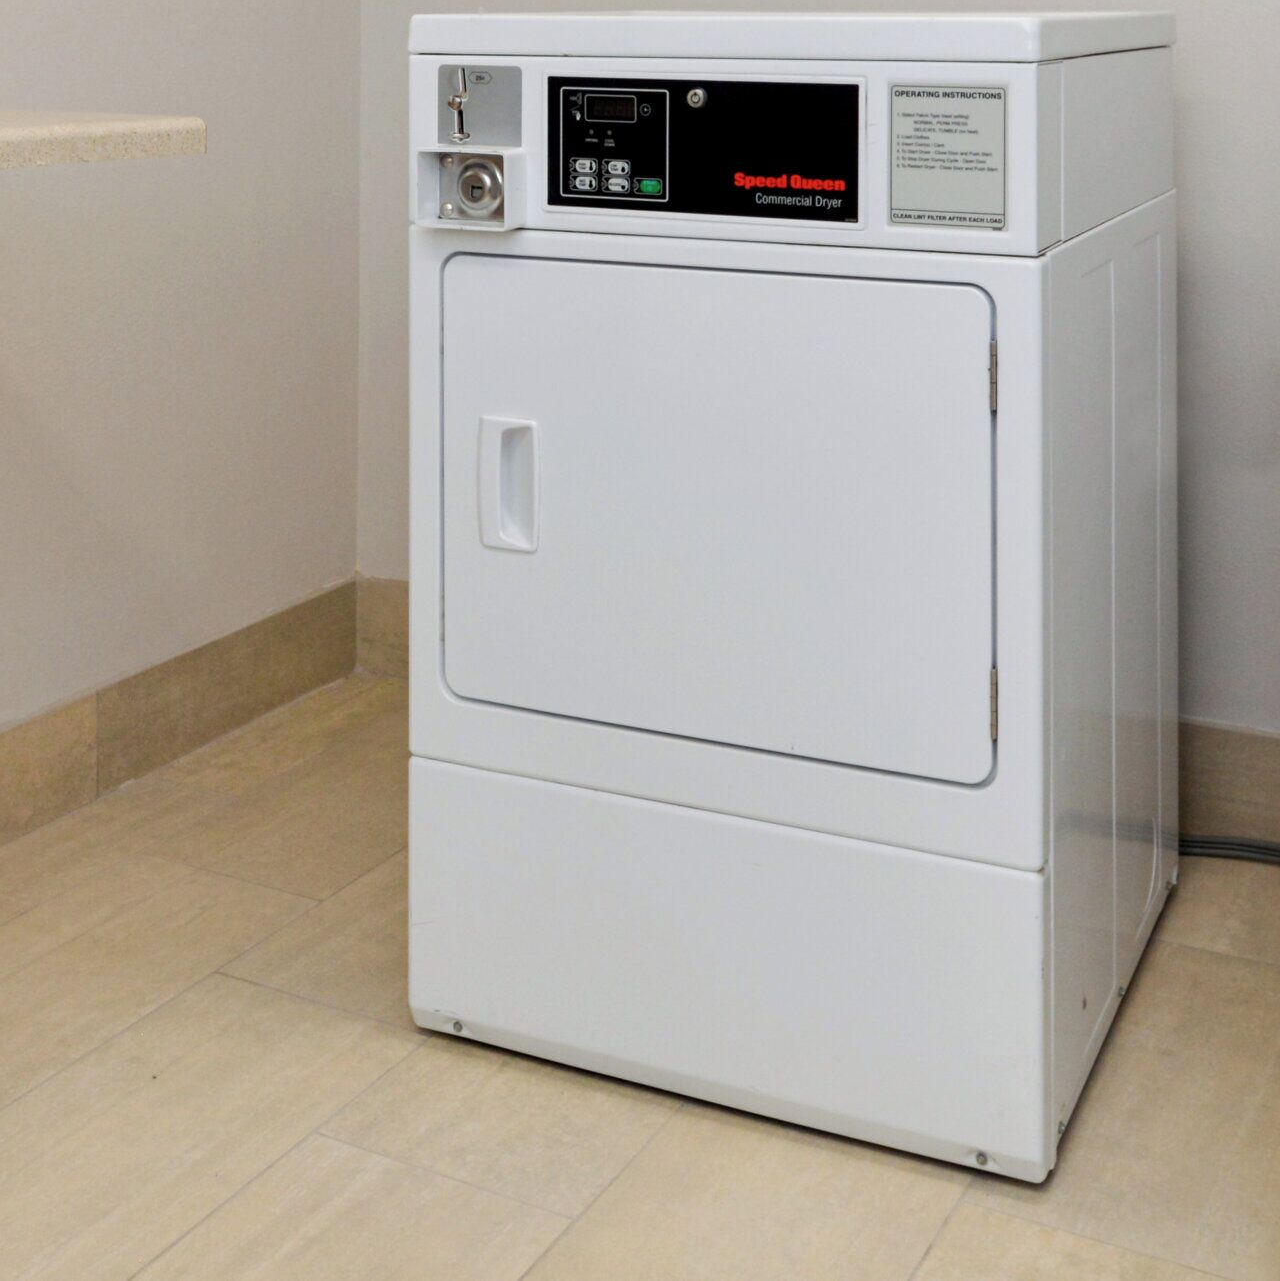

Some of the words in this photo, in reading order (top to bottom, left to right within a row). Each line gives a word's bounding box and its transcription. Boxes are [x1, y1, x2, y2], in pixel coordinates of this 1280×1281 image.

[894, 90, 940, 98] OPERATING
[942, 92, 1001, 100] INSTRUCTIONS
[734, 172, 787, 189] Speed
[791, 174, 845, 191] Queen
[756, 192, 812, 206] Commercial
[816, 196, 842, 209] Dryer
